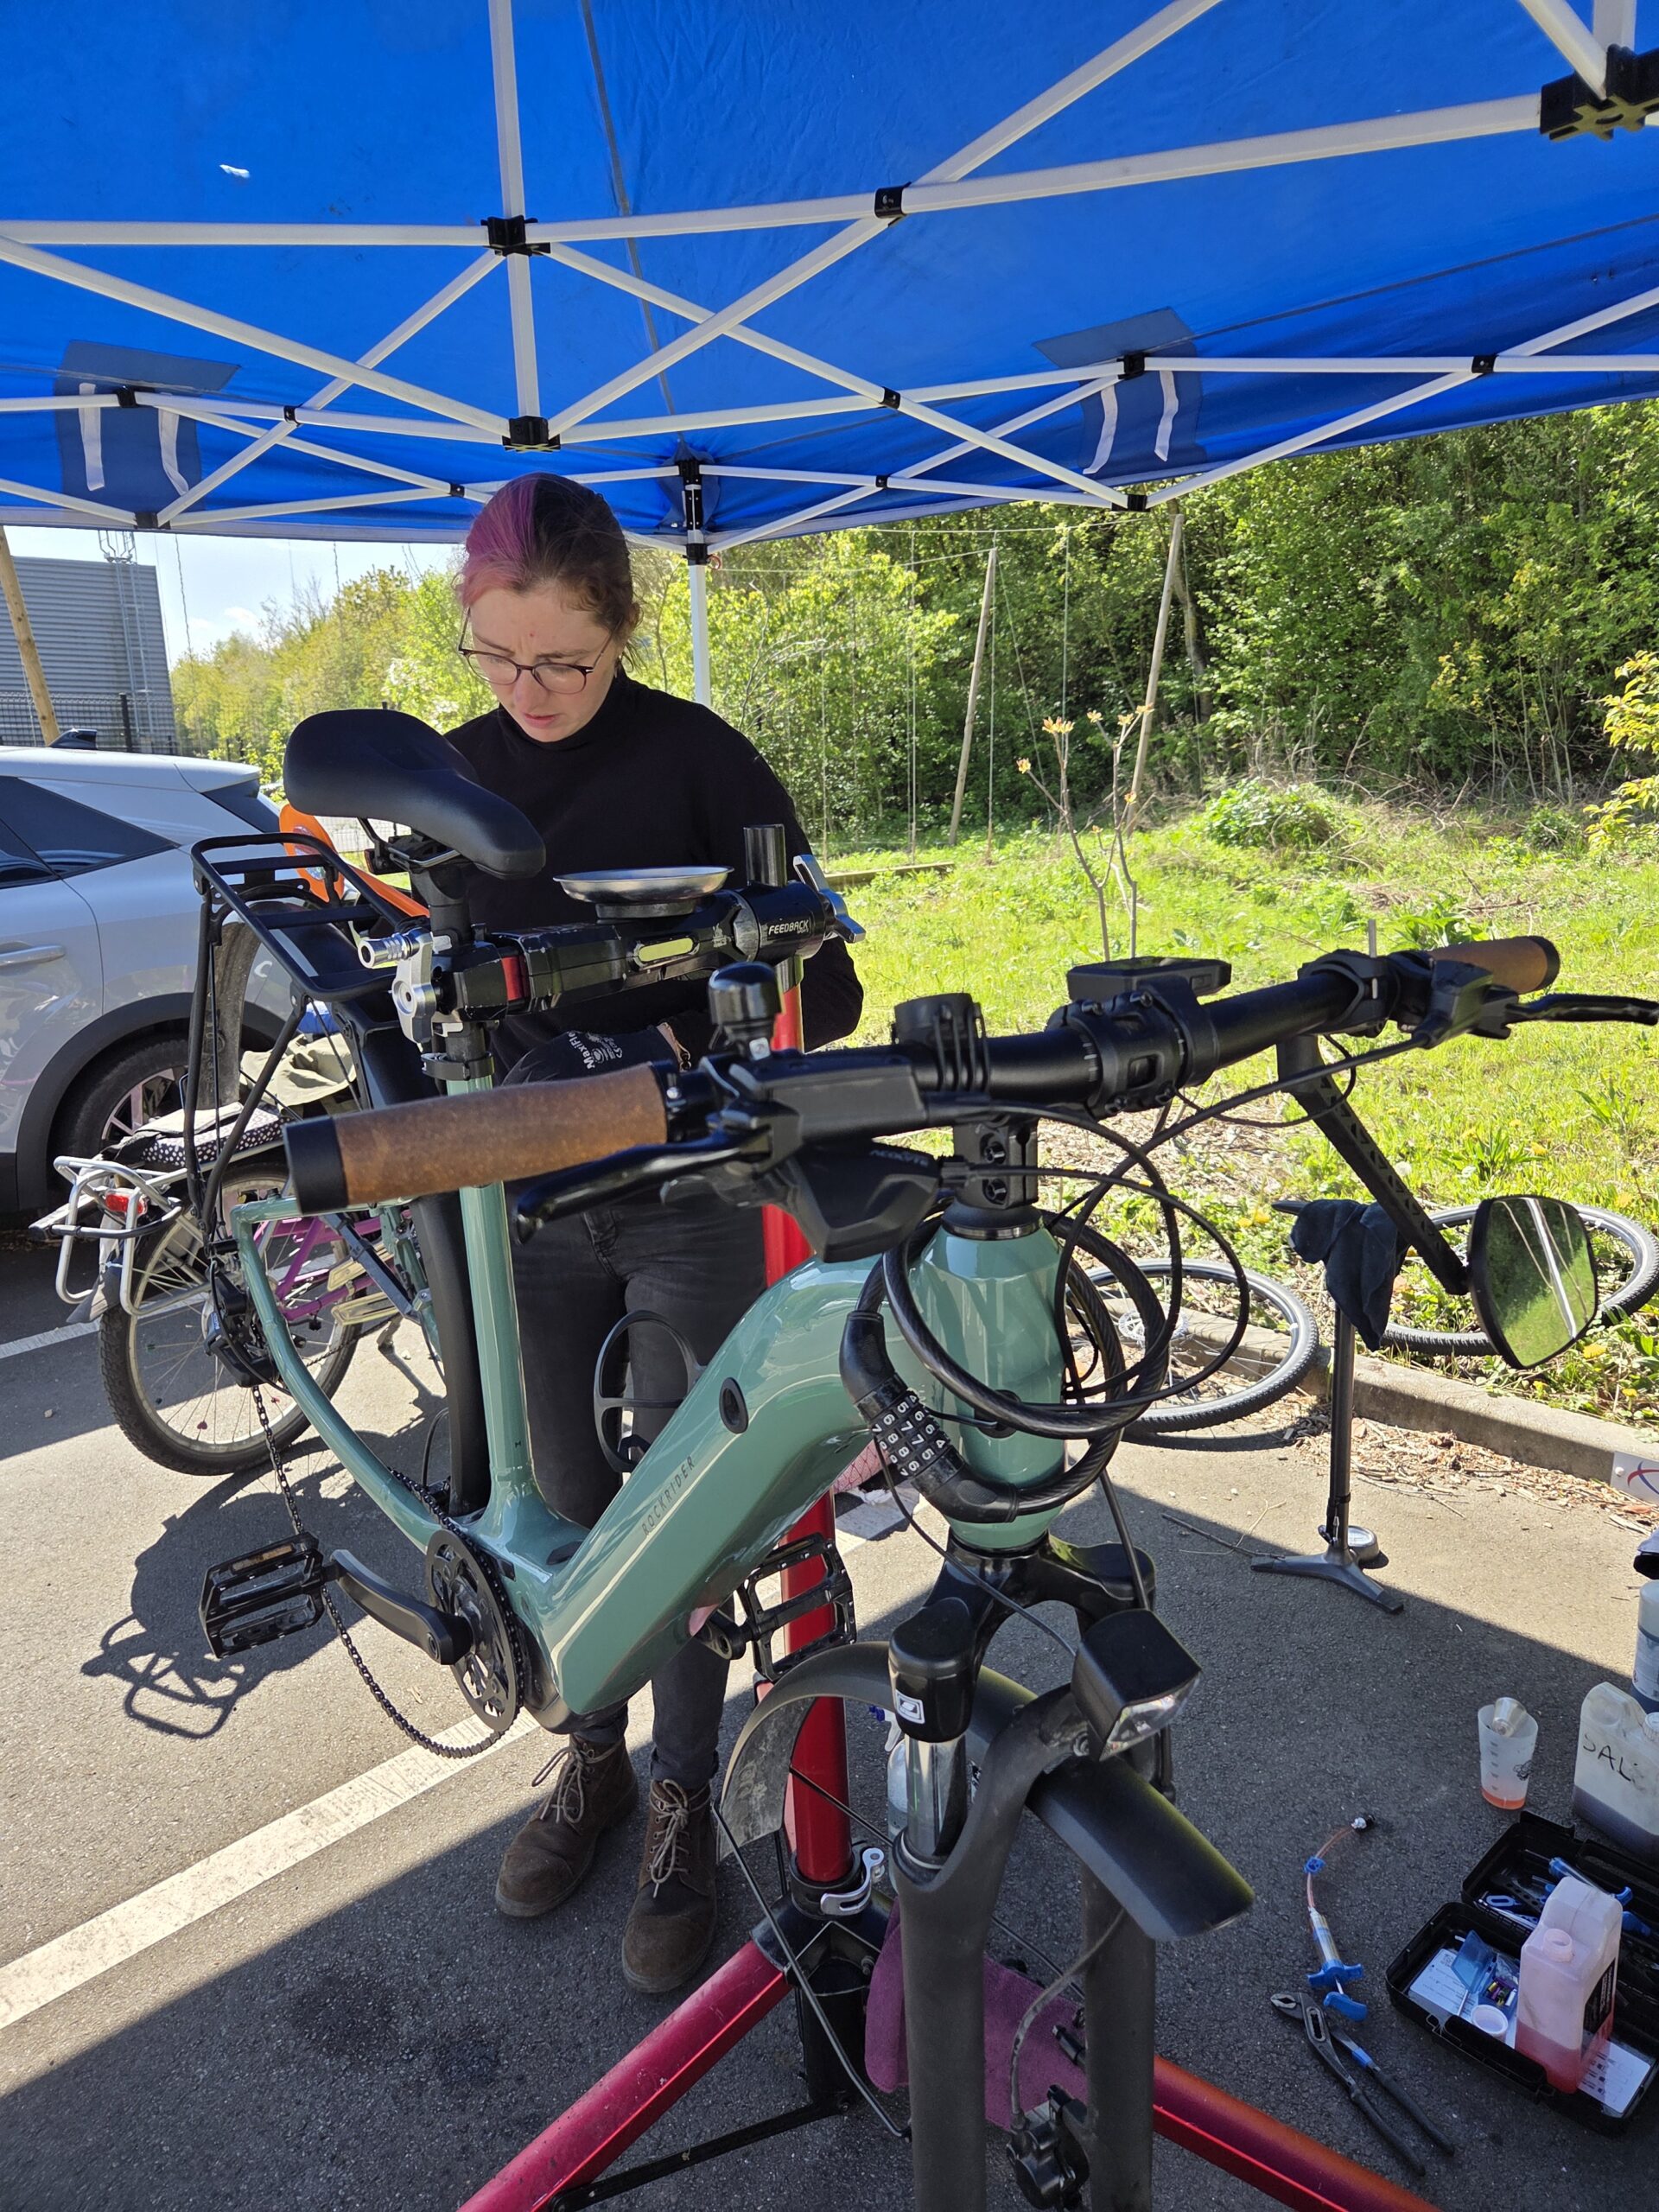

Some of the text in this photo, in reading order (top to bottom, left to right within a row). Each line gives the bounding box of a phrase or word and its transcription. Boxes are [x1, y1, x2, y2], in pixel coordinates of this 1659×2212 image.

[768, 919, 809, 936] FEEDBACK
[567, 1031, 595, 1069] MaxiFle
[883, 1414, 919, 1471] 6 8 8 6
[898, 1402, 935, 1460] 5 7 7 5
[915, 1411, 925, 1421] 6
[925, 1424, 935, 1434] 6
[936, 1440, 945, 1448] 4
[641, 1456, 695, 1536] ROCKRIDER
